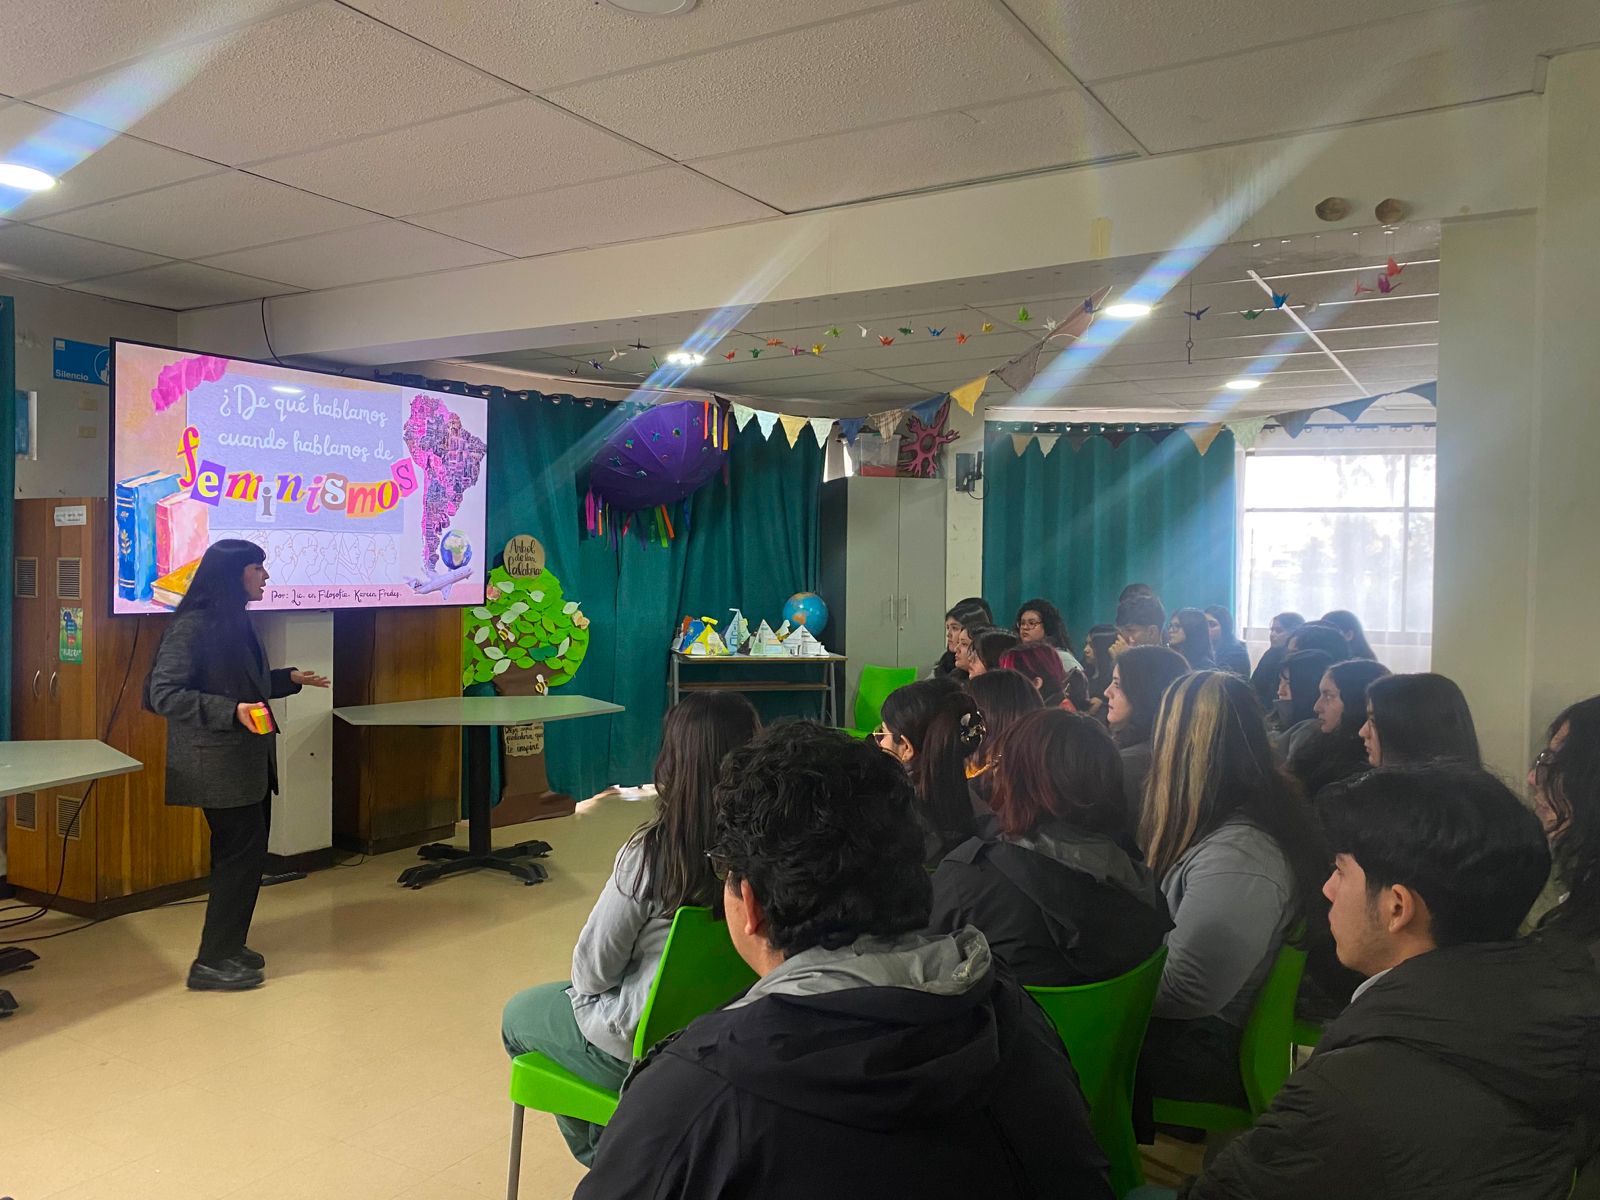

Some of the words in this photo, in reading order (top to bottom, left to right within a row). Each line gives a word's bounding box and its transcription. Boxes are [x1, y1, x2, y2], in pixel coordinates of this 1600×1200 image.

[55, 369, 89, 380] Silencio
[219, 384, 270, 420] ¿De
[274, 395, 309, 421] qué
[313, 393, 388, 427] hablamos
[218, 428, 288, 450] cuando
[293, 430, 370, 462] hablamos
[374, 440, 394, 461] de
[177, 426, 416, 517] feminismos
[514, 553, 524, 562] de
[524, 553, 536, 563] las
[271, 590, 289, 602] Por:
